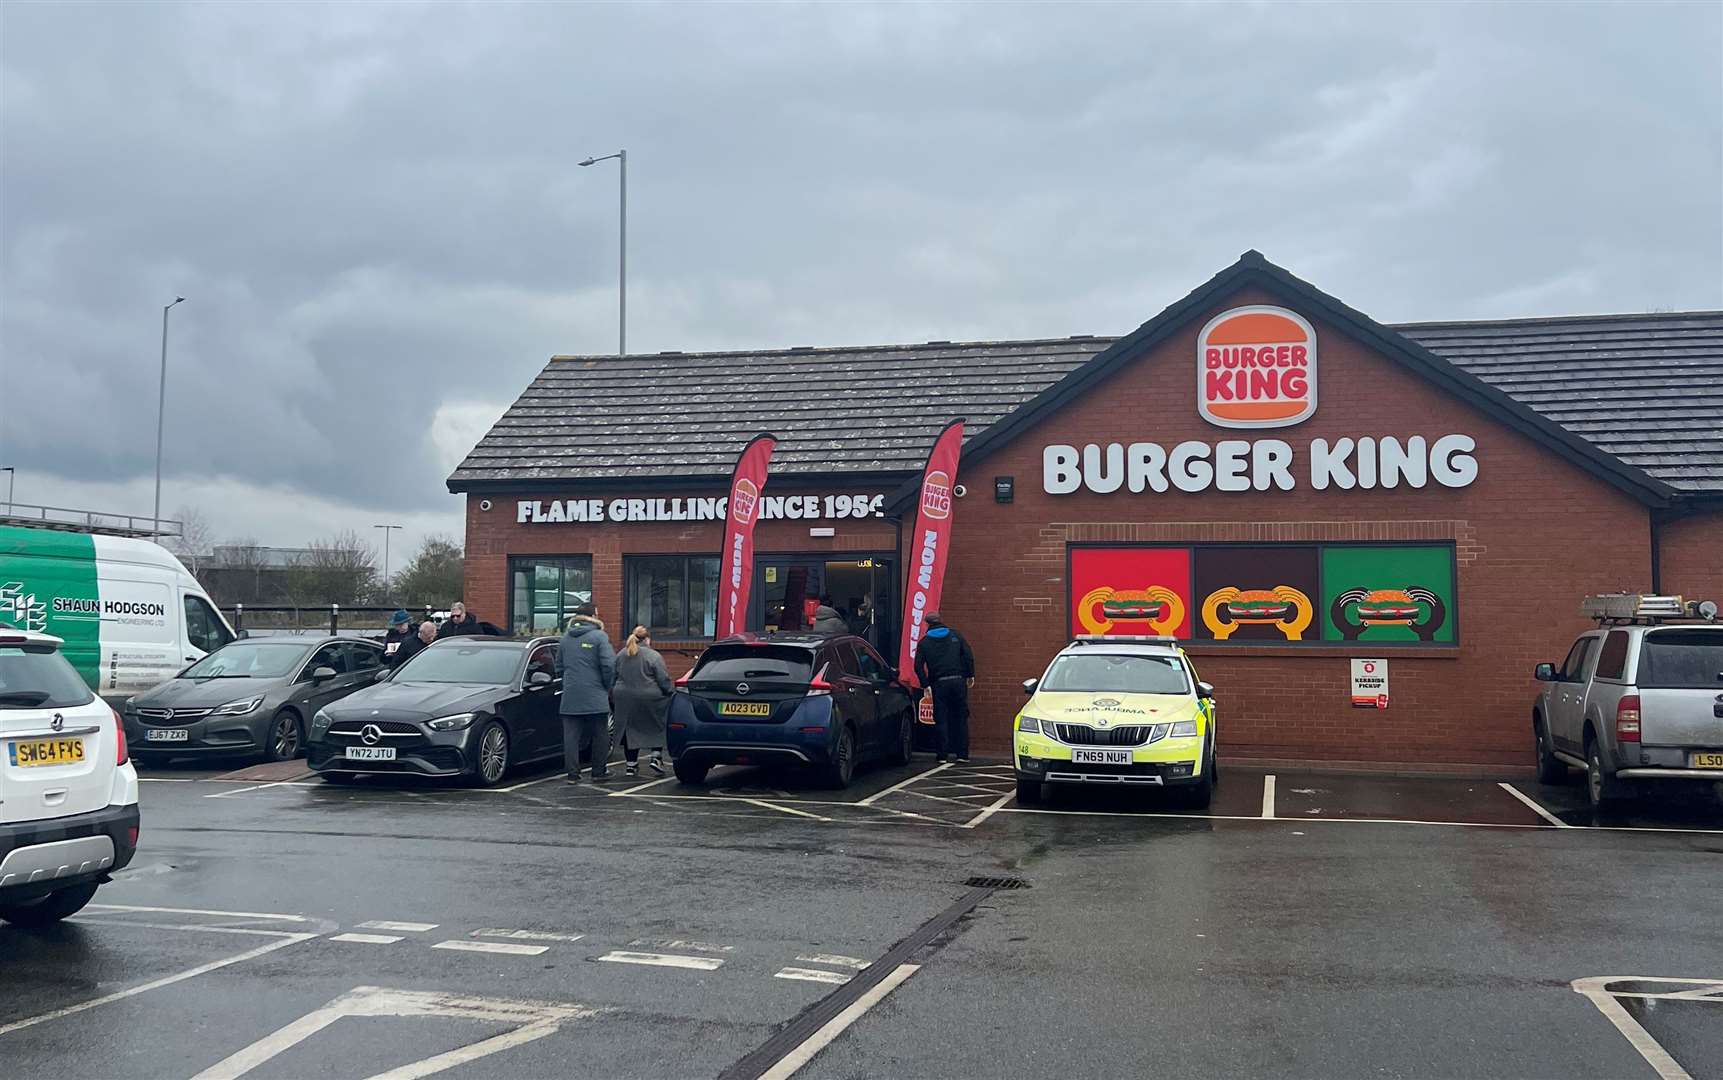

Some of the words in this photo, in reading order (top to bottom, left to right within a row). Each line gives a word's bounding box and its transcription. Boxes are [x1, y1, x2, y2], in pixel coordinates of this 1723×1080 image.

[1206, 345, 1308, 369] BURGER
[1206, 368, 1309, 401] KING
[1043, 440, 1296, 494] BURGER
[1310, 434, 1479, 490] KING
[517, 500, 604, 523] FLAME
[757, 496, 820, 519] INCE
[924, 493, 950, 511] KING
[918, 529, 937, 589] NOW
[53, 598, 100, 612] SHAUN
[104, 600, 164, 616] HODGSON
[19, 742, 56, 762] SW64
[58, 740, 83, 760] FYS
[351, 748, 372, 758] YN72
[374, 748, 393, 758] JTU
[1076, 751, 1104, 762] FN69
[1106, 752, 1128, 763] NUH
